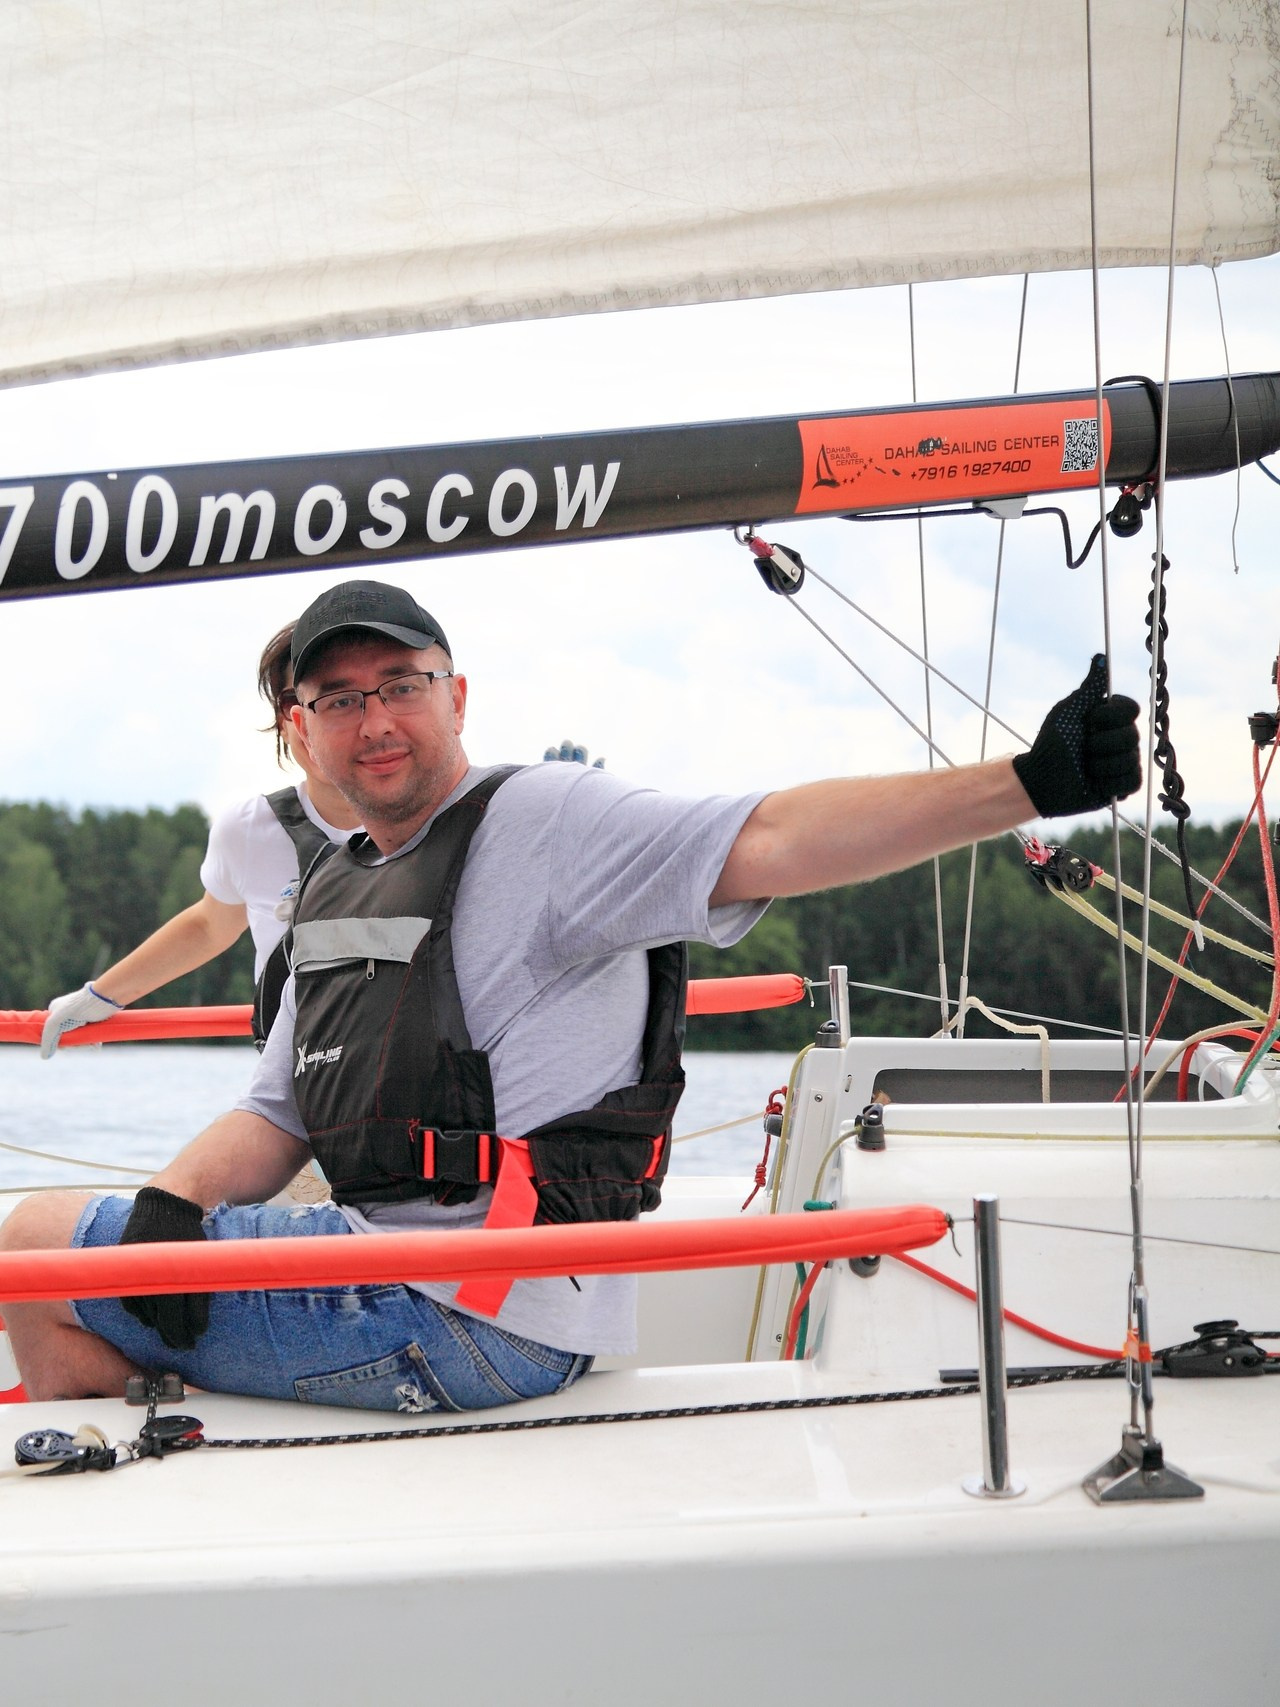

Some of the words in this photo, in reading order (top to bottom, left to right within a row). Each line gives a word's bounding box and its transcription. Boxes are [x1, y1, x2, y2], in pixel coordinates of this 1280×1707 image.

[941, 440, 997, 456] SAILING
[1004, 435, 1059, 451] CENTER
[826, 446, 851, 454] DAHAB
[830, 452, 858, 460] SAILING
[836, 458, 864, 466] CENTER
[911, 465, 958, 480] +7916
[963, 459, 1031, 478] 1927400
